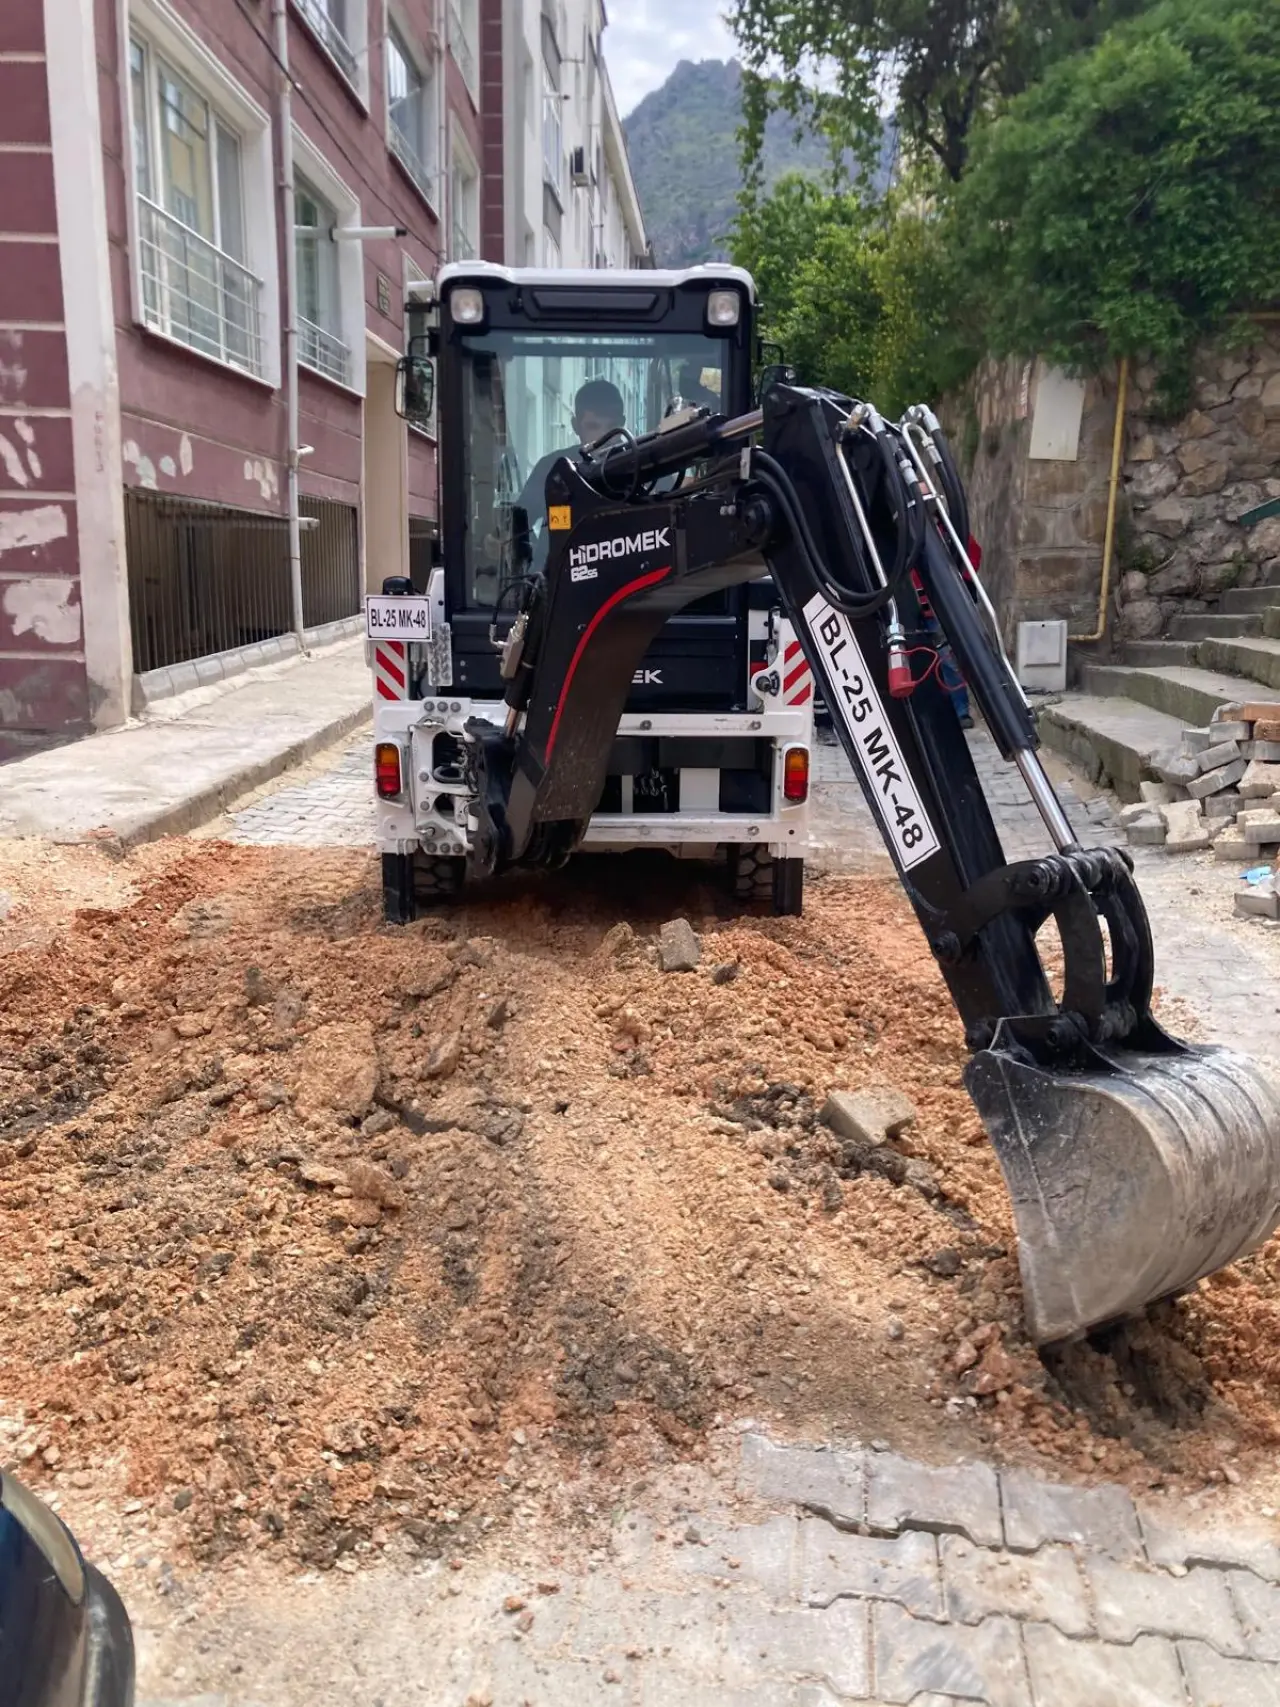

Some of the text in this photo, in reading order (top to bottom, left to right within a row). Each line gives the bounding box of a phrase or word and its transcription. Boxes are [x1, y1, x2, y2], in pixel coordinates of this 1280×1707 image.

[371, 608, 427, 629] BL-25 MK-48
[820, 613, 923, 849] BL-25 MK-48
